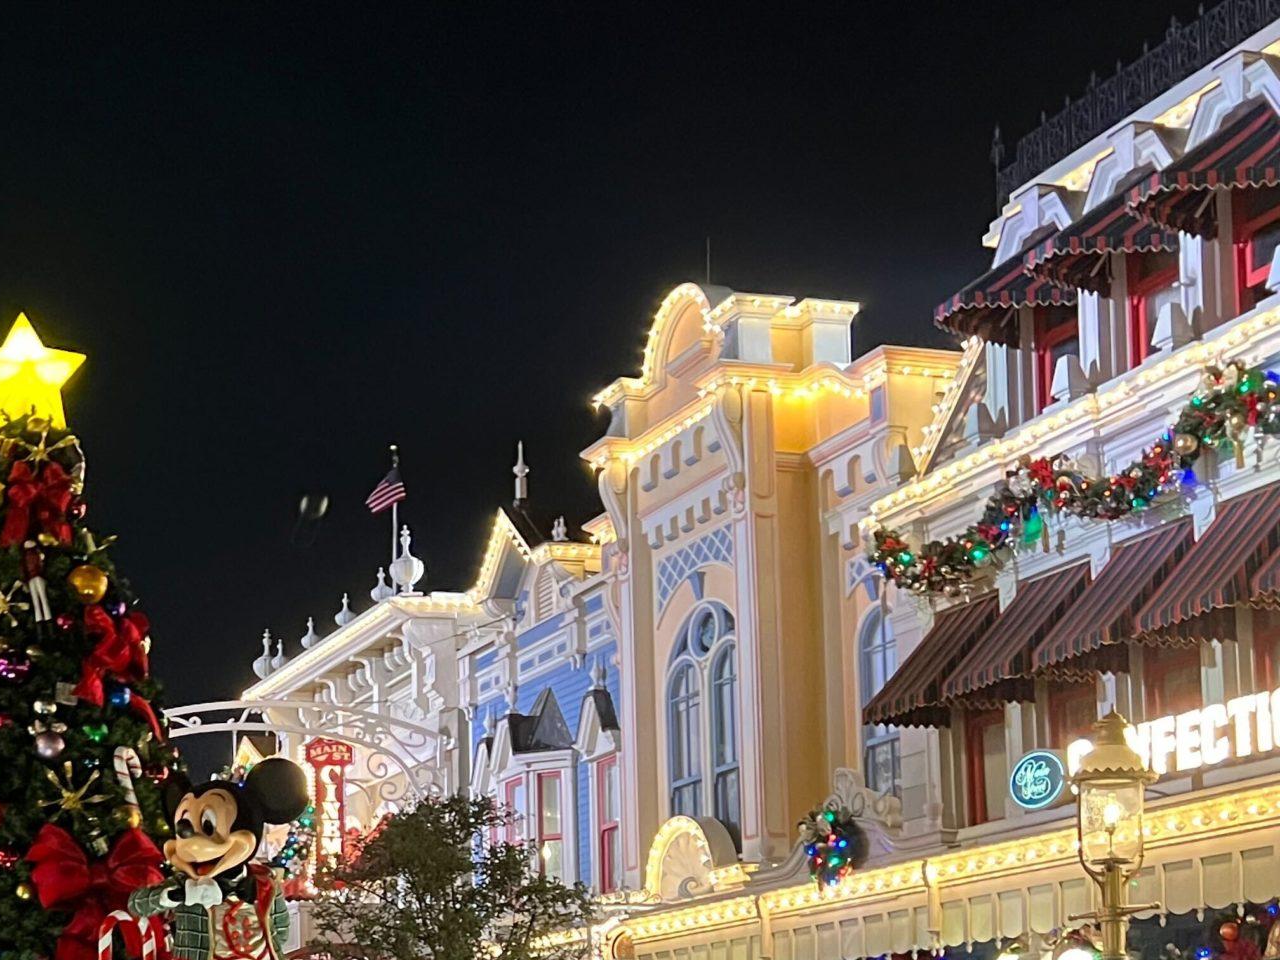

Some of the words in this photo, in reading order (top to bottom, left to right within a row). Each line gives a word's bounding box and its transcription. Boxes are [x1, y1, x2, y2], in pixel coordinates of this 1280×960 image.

[1067, 687, 1280, 777] CNFECTI
[309, 744, 348, 757] MAIN
[331, 752, 351, 760] ST
